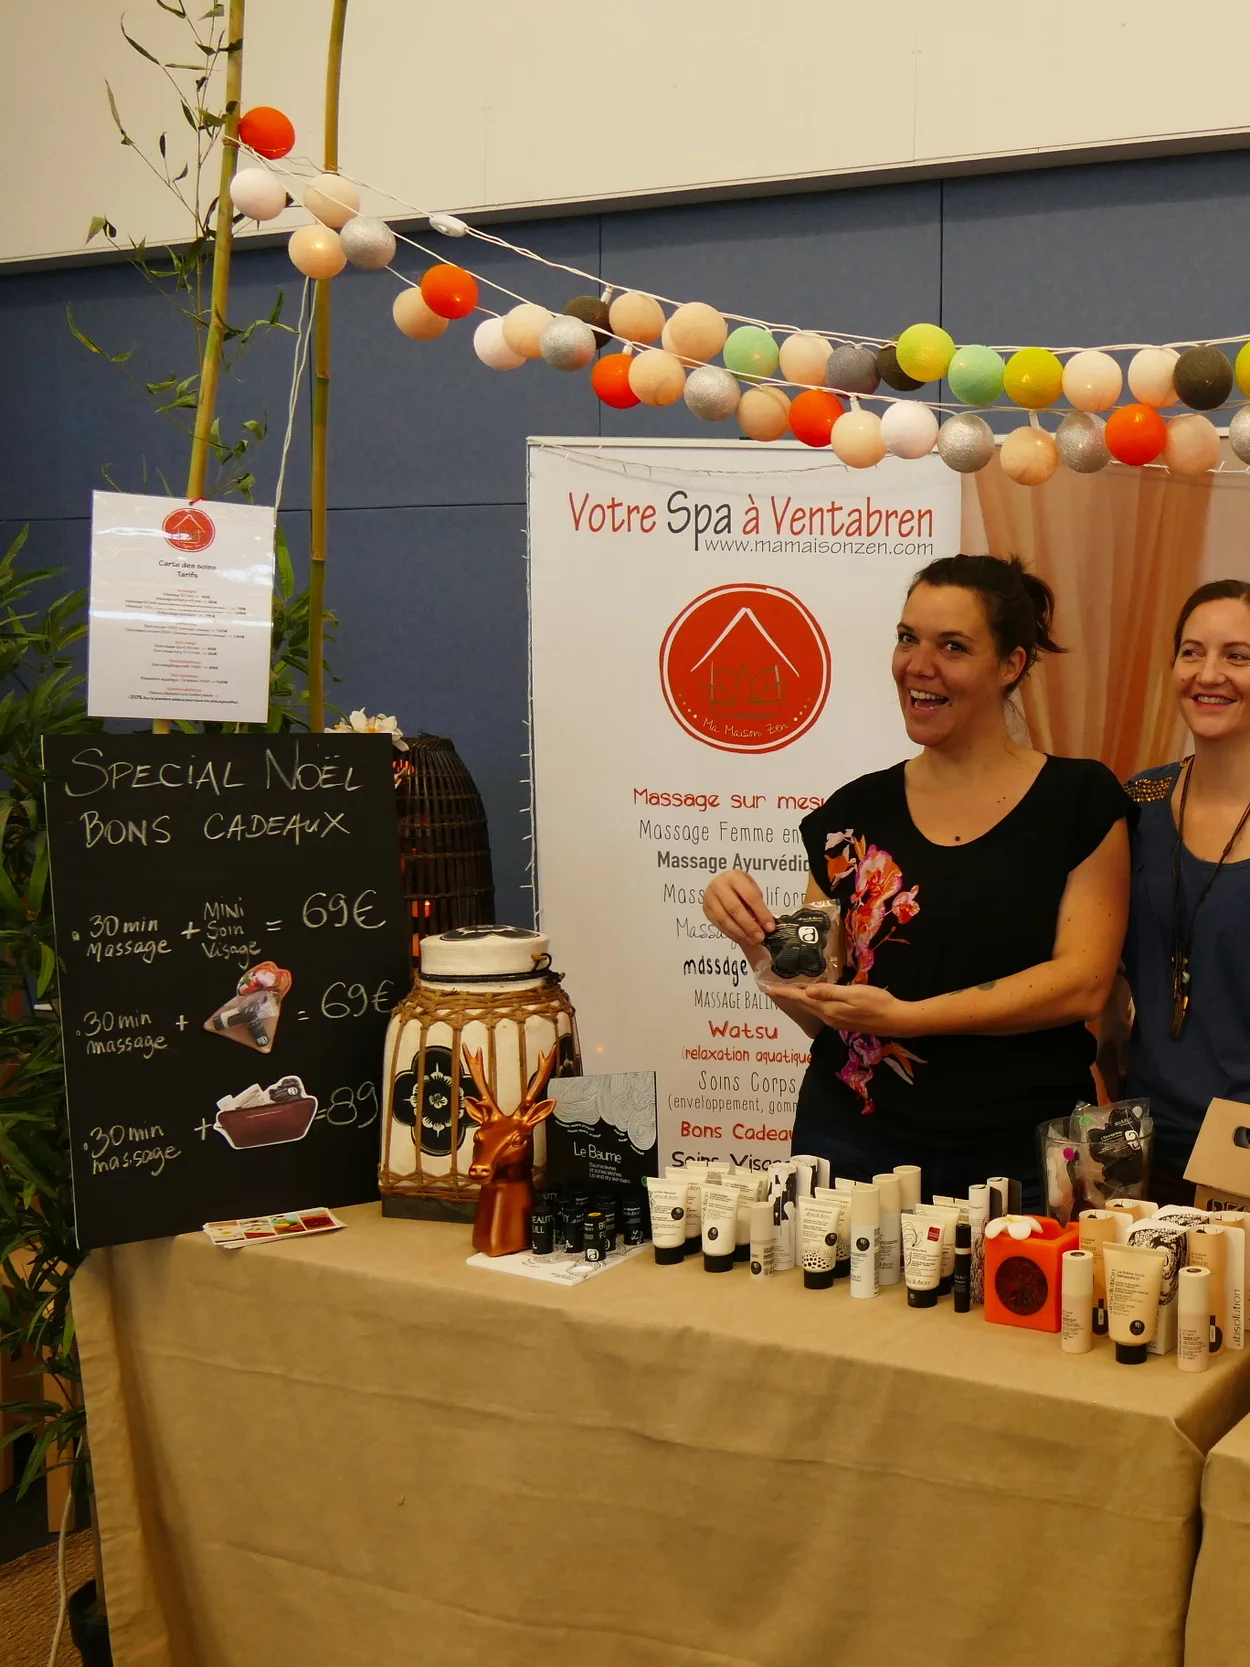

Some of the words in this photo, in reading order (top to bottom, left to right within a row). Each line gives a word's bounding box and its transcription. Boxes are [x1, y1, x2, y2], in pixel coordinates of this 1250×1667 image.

[568, 492, 657, 534] Votre
[667, 490, 732, 551] Spa
[742, 494, 760, 535] à
[770, 495, 934, 538] Ventabren
[704, 537, 934, 556] www.mamaisonzen.com
[703, 718, 720, 733] Ma
[725, 724, 762, 738] Maison
[765, 723, 789, 735] Zen
[633, 788, 720, 812] Massage
[731, 793, 766, 809] sur
[80, 810, 171, 849] BONS
[639, 820, 709, 845] Massage
[720, 821, 774, 843] Femme
[783, 829, 802, 844] en
[657, 851, 727, 874] Massage
[663, 883, 705, 905] Mass
[302, 889, 387, 929] 69€
[86, 939, 172, 964] Massage
[206, 920, 244, 939] Soin
[201, 940, 261, 970] Visage
[683, 955, 748, 987] massage
[321, 979, 395, 1019] 69€
[694, 989, 741, 1010] MASSAGE
[708, 1020, 779, 1040] Watsu
[86, 1035, 168, 1059] massage
[698, 1070, 740, 1091] Soins
[751, 1071, 797, 1097] Corps
[680, 1121, 722, 1139] Bons
[574, 1141, 587, 1157] Le
[589, 1144, 622, 1163] Baume
[1232, 1289, 1241, 1346] absolution
